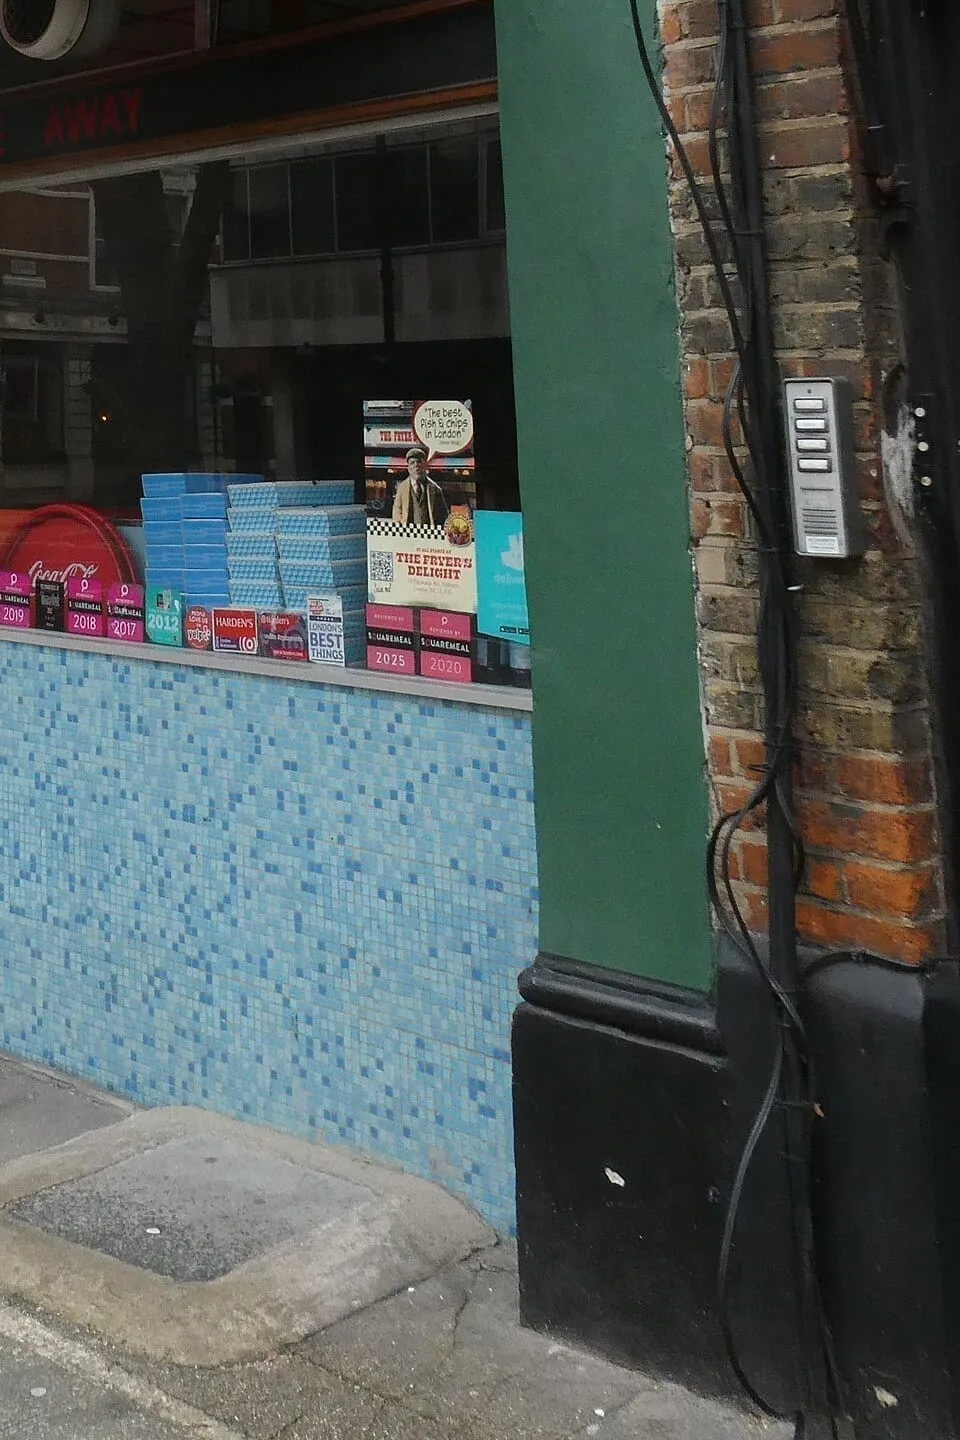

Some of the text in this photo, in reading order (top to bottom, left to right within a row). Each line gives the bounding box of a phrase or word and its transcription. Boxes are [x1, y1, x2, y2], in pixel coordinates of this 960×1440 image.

[44, 88, 141, 147] AWAY
[443, 408, 463, 418] best
[396, 552, 473, 569] THE FRYER'S
[408, 565, 461, 580] DELIGHT
[3, 606, 24, 622] 2019
[73, 614, 97, 630] 2018
[148, 613, 179, 631] 2012
[113, 620, 137, 636] 2017
[216, 616, 254, 629] HARDEN'S
[309, 622, 343, 633] LONDON'S
[310, 631, 343, 649] BEST
[310, 647, 344, 660] THINGS
[376, 651, 405, 667] 2025
[430, 657, 462, 674] 2020
